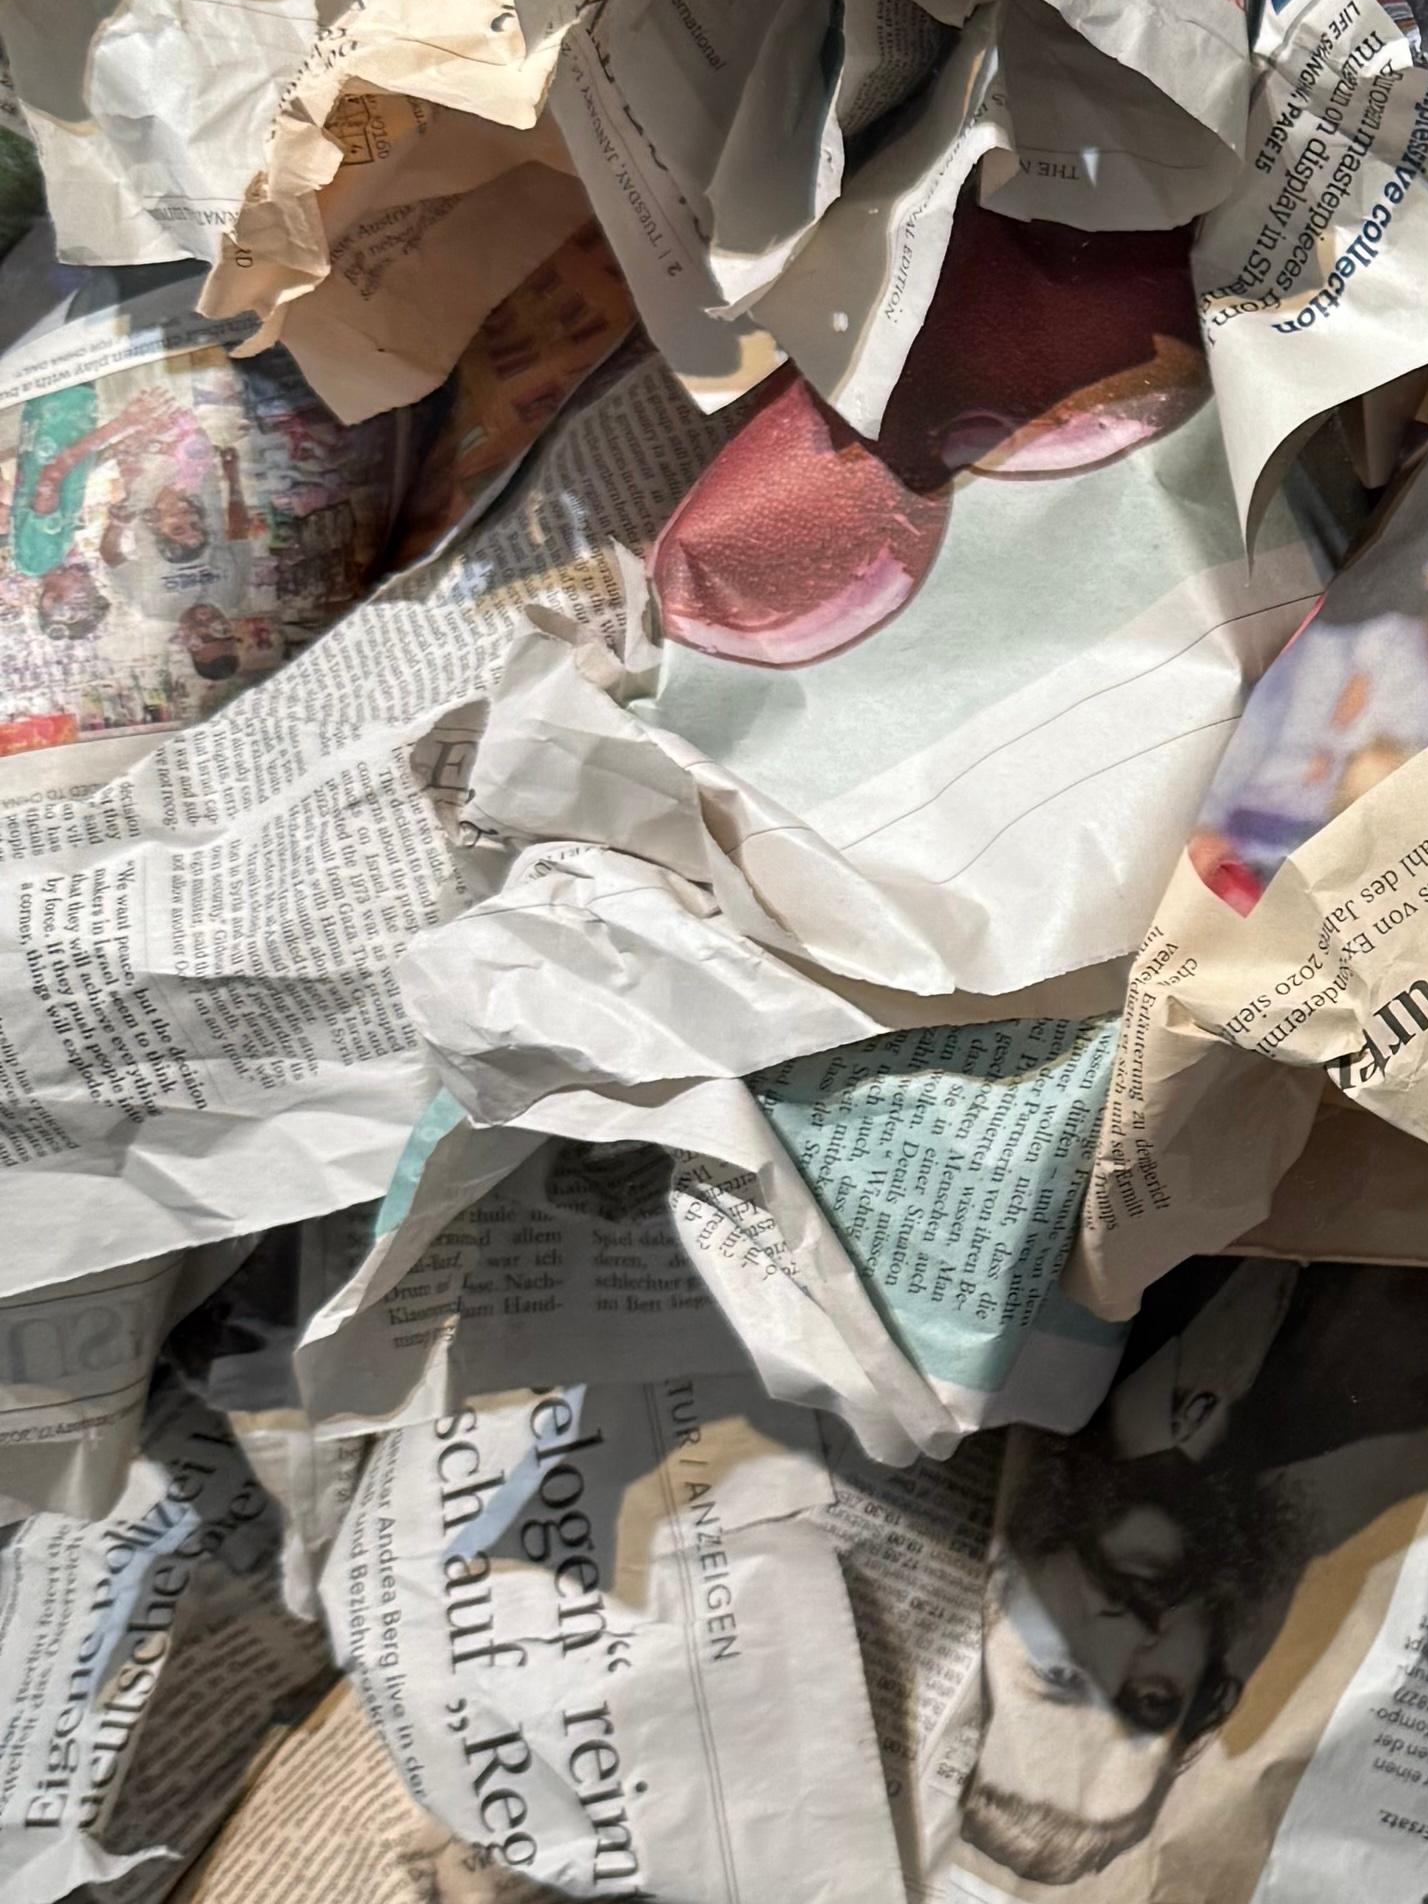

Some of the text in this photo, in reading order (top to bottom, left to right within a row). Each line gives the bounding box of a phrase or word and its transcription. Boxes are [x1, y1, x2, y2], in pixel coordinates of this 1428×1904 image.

[1253, 148, 1277, 175] 15
[1263, 101, 1305, 155] PAGE
[1255, 136, 1330, 252] display in
[1275, 126, 1374, 291] masterpieces
[1273, 203, 1393, 335] collection
[1359, 869, 1400, 905] des
[1371, 901, 1419, 936] von
[132, 986, 208, 1114] but the decision
[375, 1516, 403, 1669] Andrea Berg
[442, 1549, 523, 1670] auf
[683, 1480, 741, 1662] ANZEIGEN
[446, 1699, 537, 1877] „Reg
